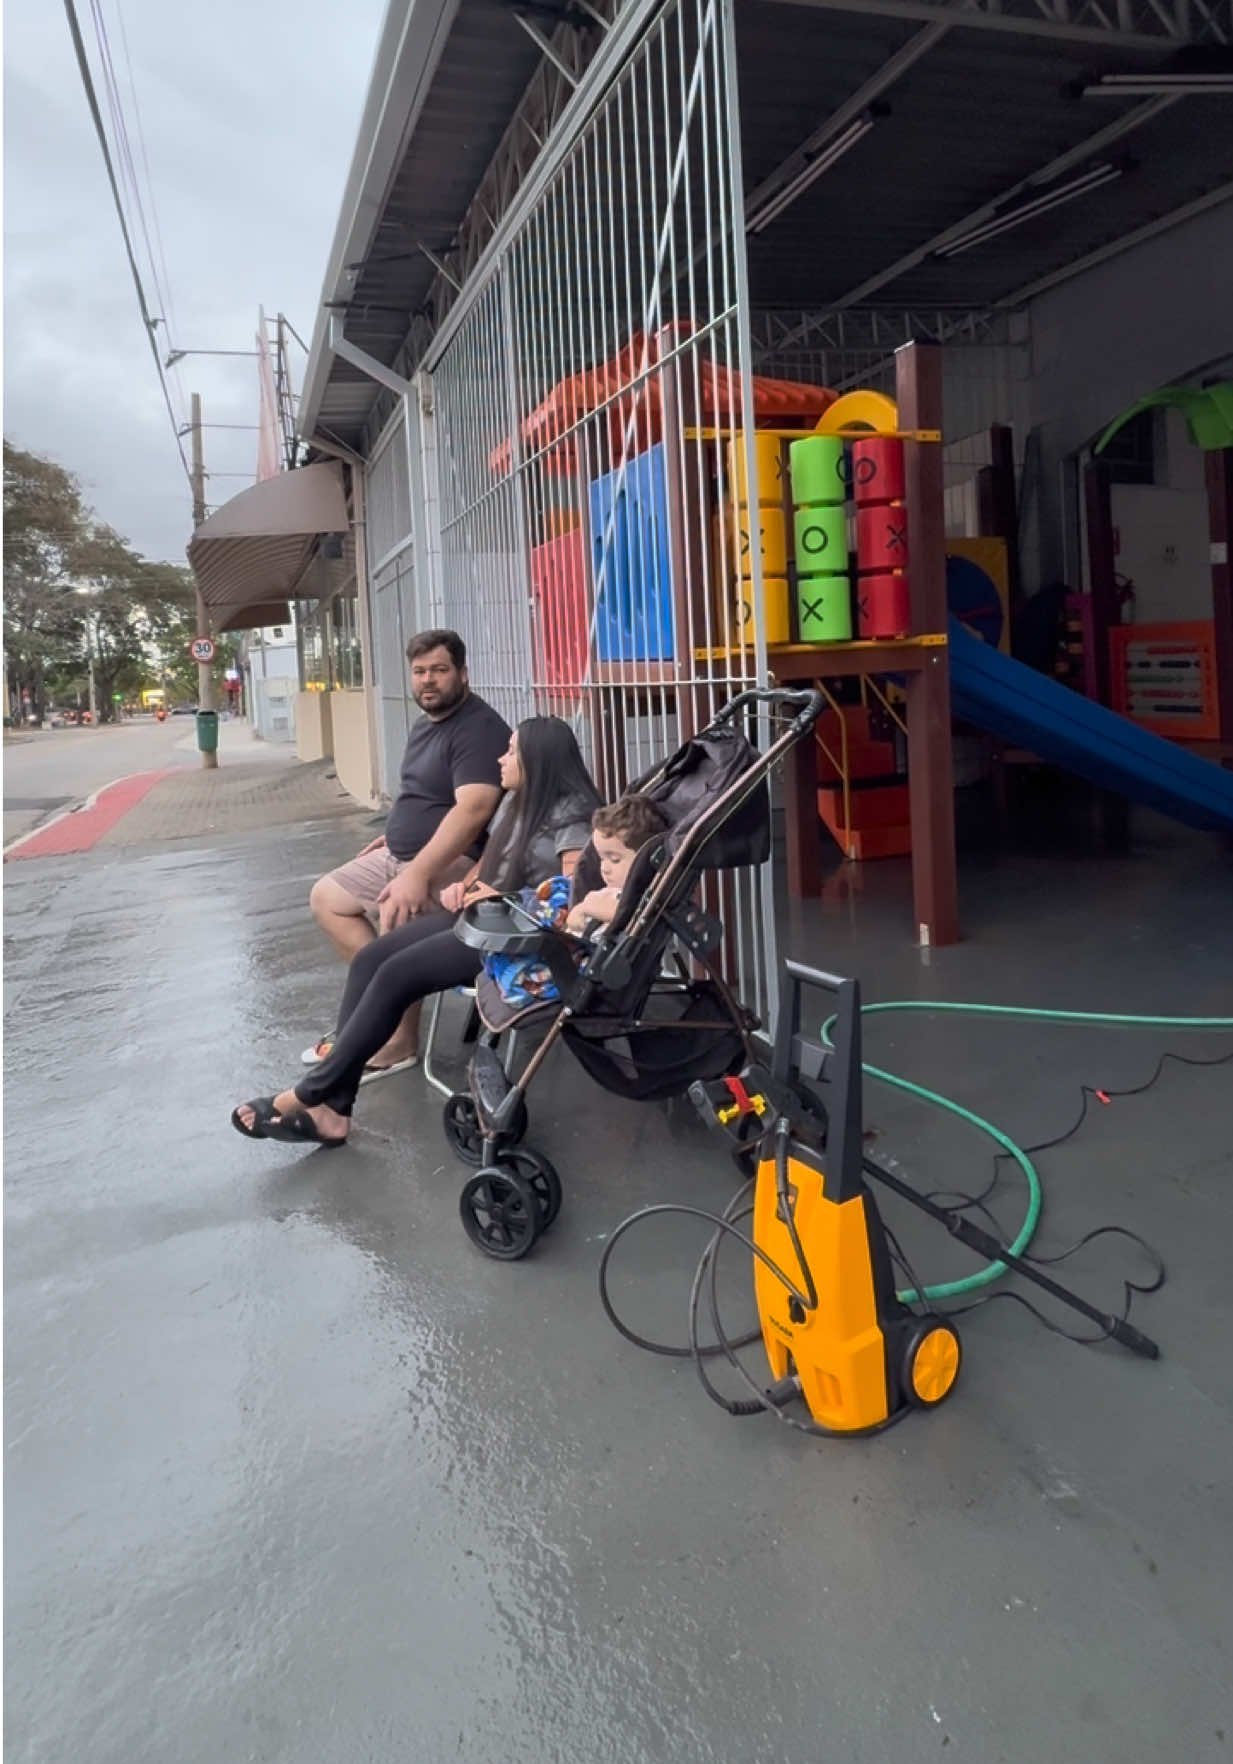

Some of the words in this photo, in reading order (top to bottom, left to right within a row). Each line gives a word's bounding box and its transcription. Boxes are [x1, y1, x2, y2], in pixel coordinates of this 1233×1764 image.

[855, 456, 877, 485] O
[802, 526, 828, 553] O
[885, 525, 905, 551] X
[802, 598, 824, 623] X
[194, 642, 212, 653] 30
